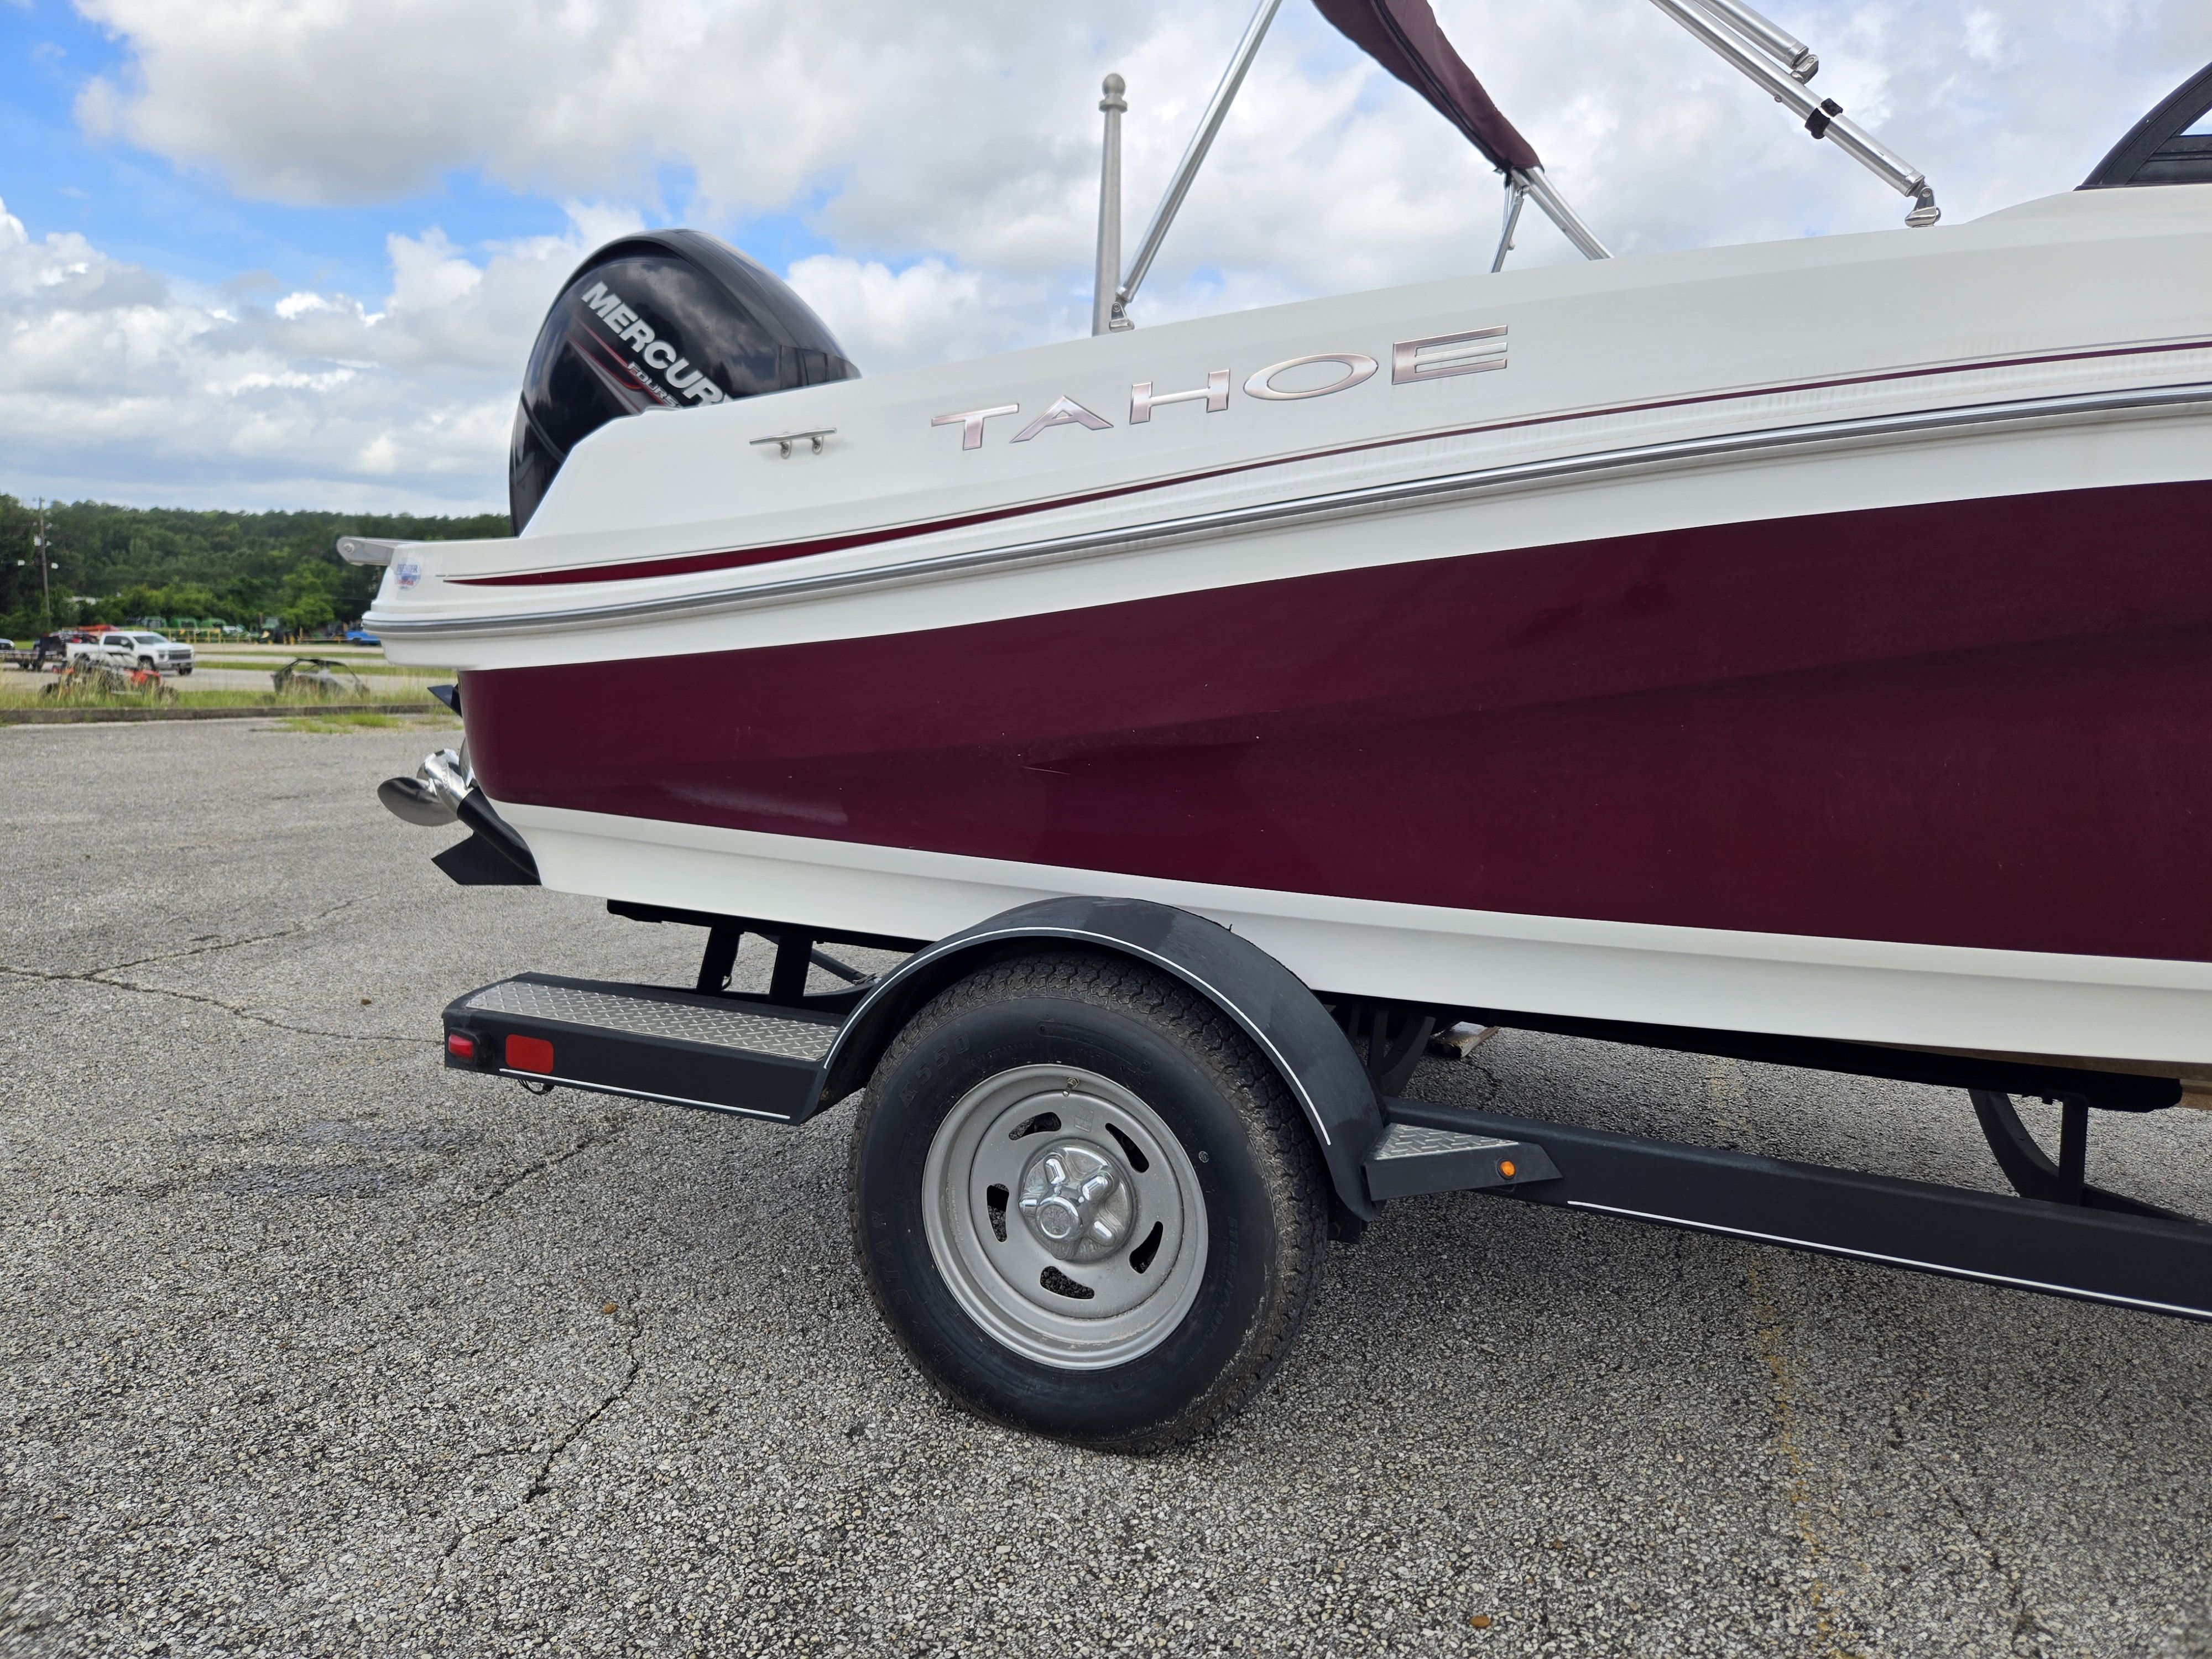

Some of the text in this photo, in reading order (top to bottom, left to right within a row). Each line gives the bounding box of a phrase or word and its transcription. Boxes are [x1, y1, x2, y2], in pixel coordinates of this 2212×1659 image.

[581, 281, 734, 407] MERCUR
[627, 361, 682, 409] FOURS
[931, 325, 1508, 451] TAHOE
